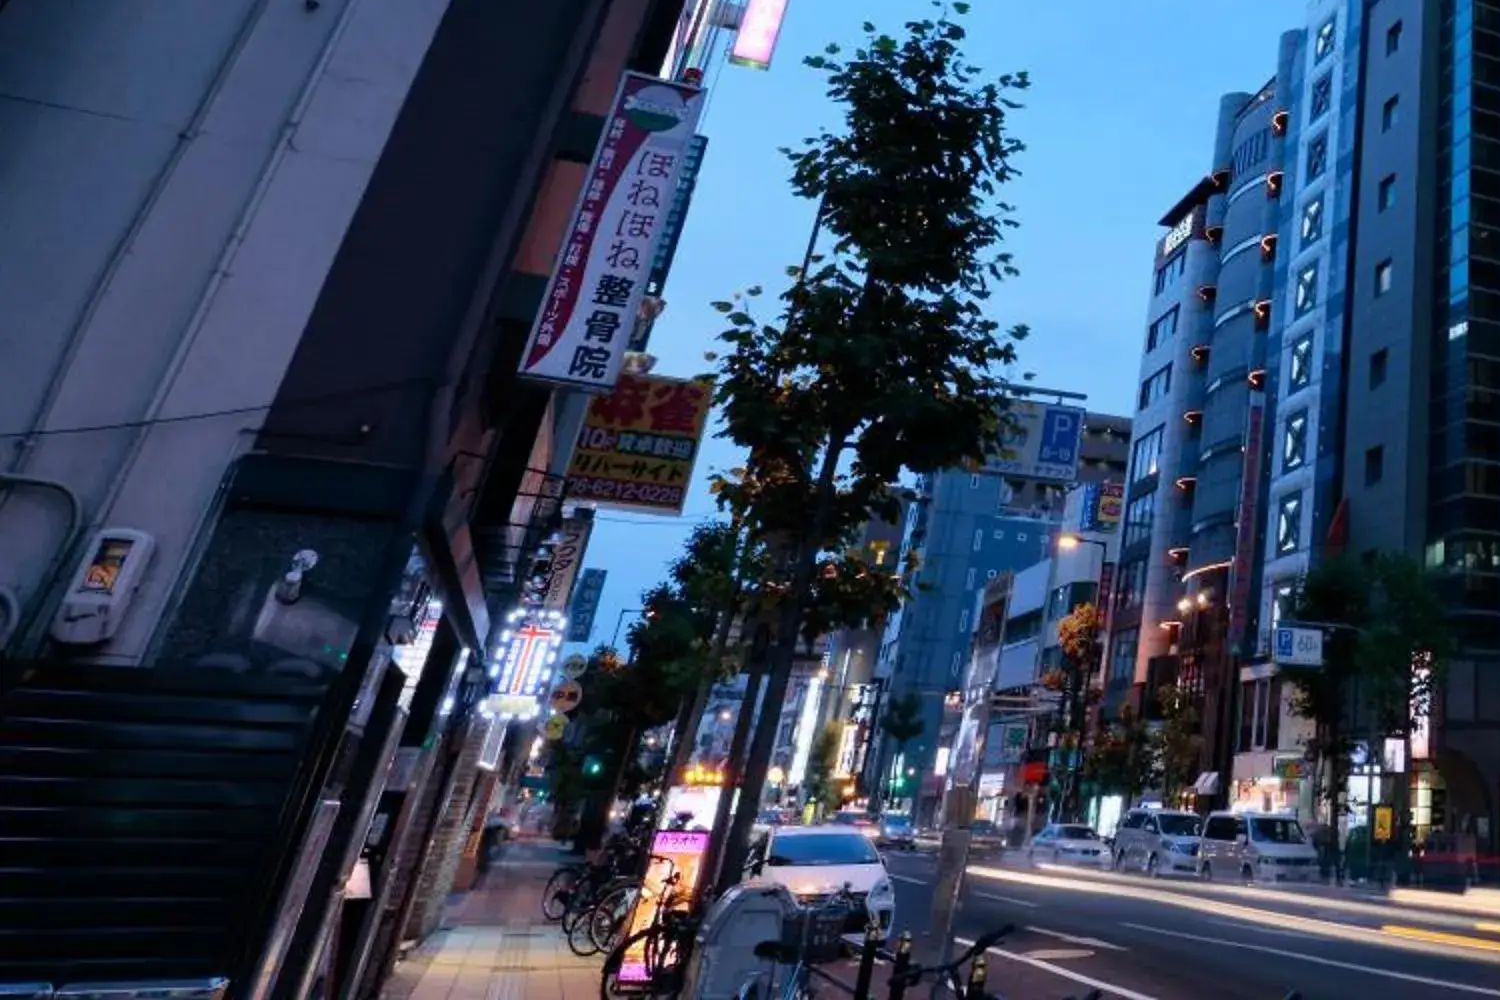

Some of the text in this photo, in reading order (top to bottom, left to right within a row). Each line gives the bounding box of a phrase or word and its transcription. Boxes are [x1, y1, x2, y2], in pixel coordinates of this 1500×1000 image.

[568, 150, 677, 380] ほねほね整骨院
[1052, 414, 1072, 444] P
[1281, 631, 1292, 647] P
